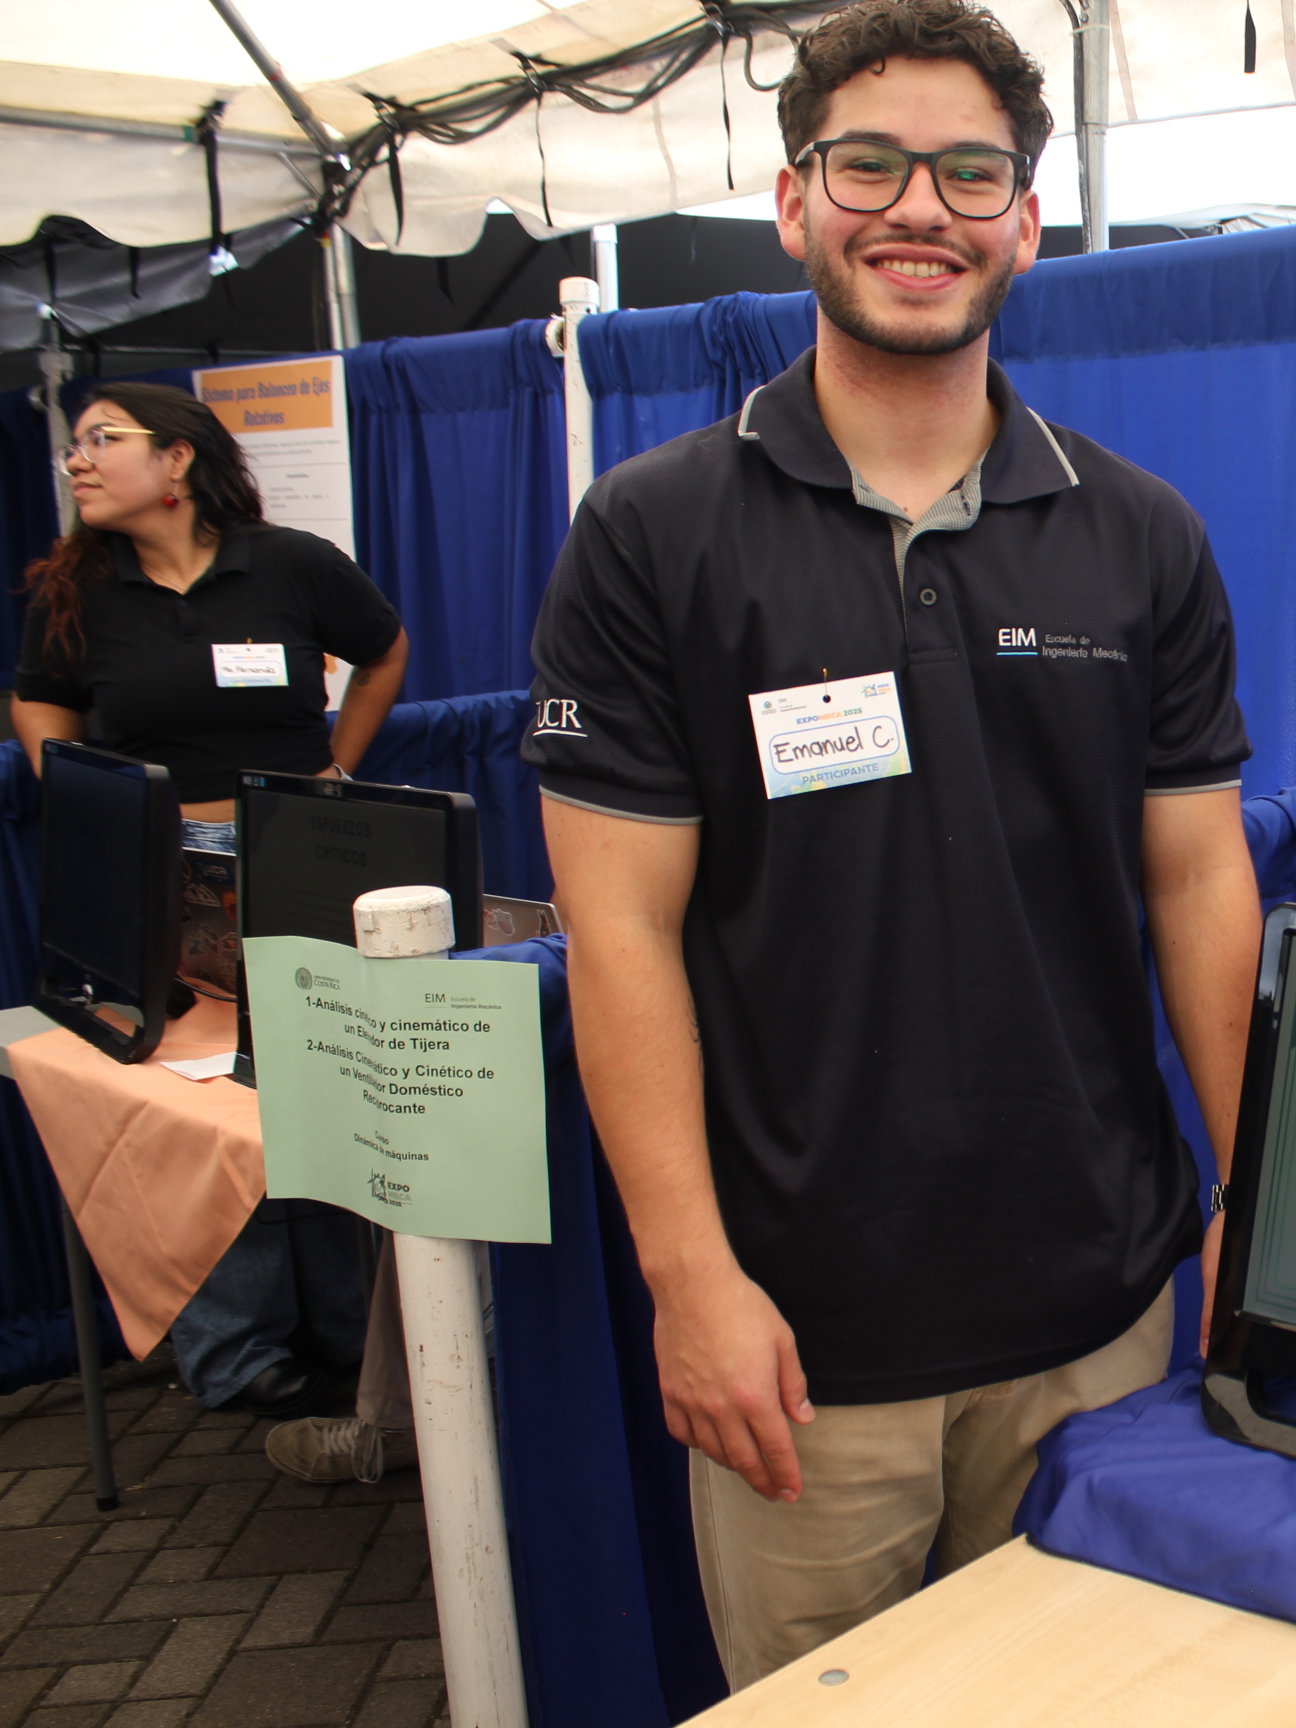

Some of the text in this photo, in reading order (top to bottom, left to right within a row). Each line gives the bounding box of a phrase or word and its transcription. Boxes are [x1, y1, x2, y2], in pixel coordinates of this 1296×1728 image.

[236, 387, 256, 403] para
[257, 380, 297, 399] Balanceo
[299, 378, 310, 395] de
[312, 376, 330, 397] Ejes
[243, 409, 286, 427] Rotativos
[998, 628, 1037, 647] EIM
[1045, 633, 1091, 645] Escuela de
[535, 698, 582, 729] UCR
[796, 707, 863, 725] EXPOMECA 2025
[773, 726, 864, 763] Emanuel
[801, 763, 880, 785] PARTICIPANTE
[311, 814, 371, 838] ESFUERZOS
[424, 993, 446, 1003] EIM
[305, 996, 353, 1016] 1-Análisis
[378, 1021, 386, 1033] y
[390, 1019, 469, 1032] cinemático
[473, 1020, 490, 1032] de
[344, 1024, 355, 1035] un
[388, 1038, 405, 1050] de
[409, 1038, 450, 1053] Tijera
[307, 1039, 354, 1061] 2-Análisis
[402, 1067, 410, 1079] y
[415, 1064, 473, 1078] Cinético
[477, 1067, 494, 1079] de
[340, 1066, 351, 1077] un
[389, 1083, 464, 1097] Doméstico
[385, 1149, 429, 1162] máquinas
[387, 1181, 410, 1193] EXPO
